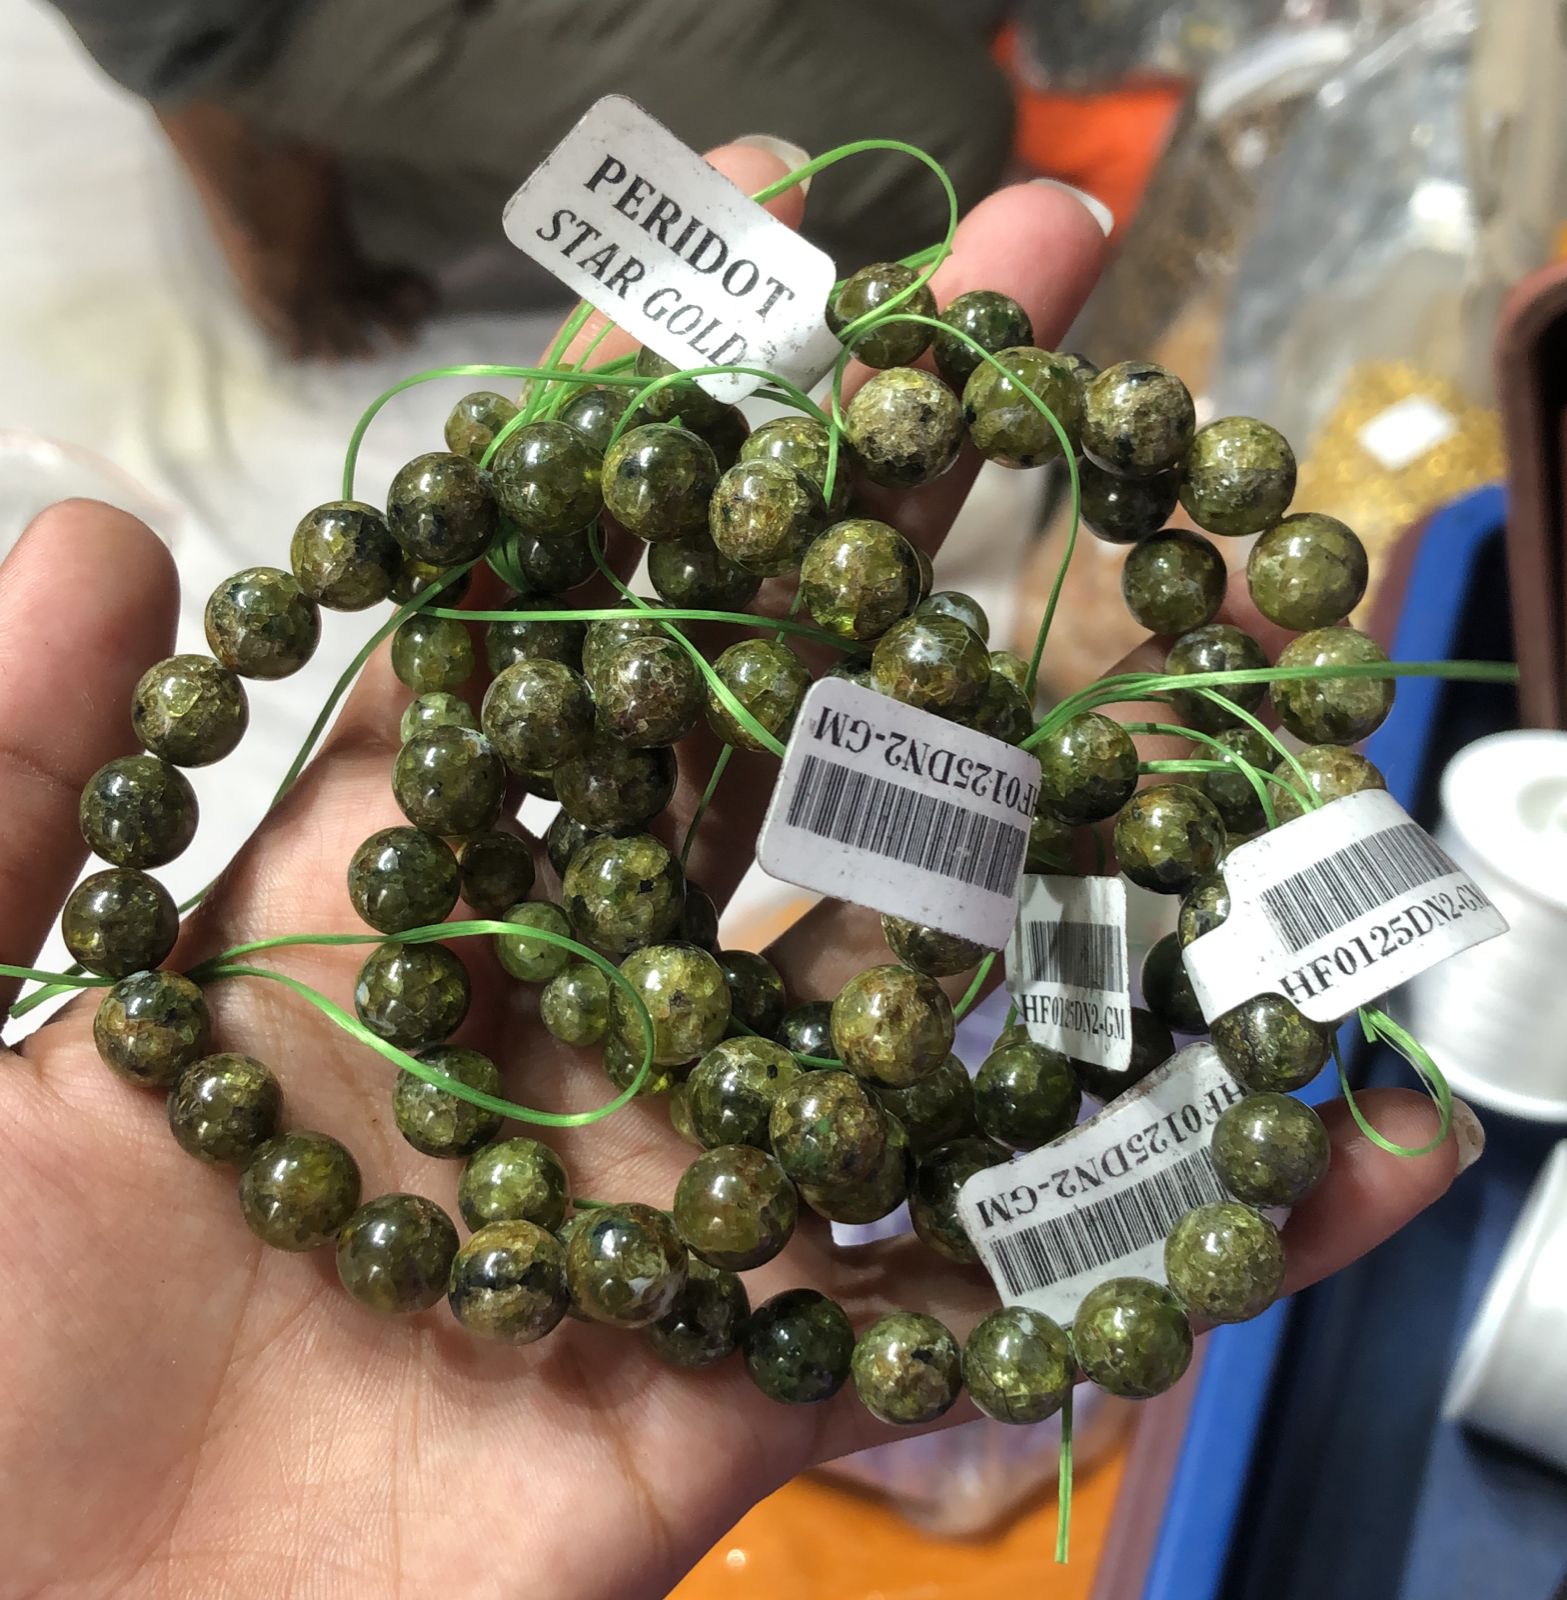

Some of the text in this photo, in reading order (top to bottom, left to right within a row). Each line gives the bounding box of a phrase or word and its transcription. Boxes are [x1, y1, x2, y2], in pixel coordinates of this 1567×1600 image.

[535, 208, 749, 367] STAR GOLD
[583, 153, 795, 319] PERIDOT
